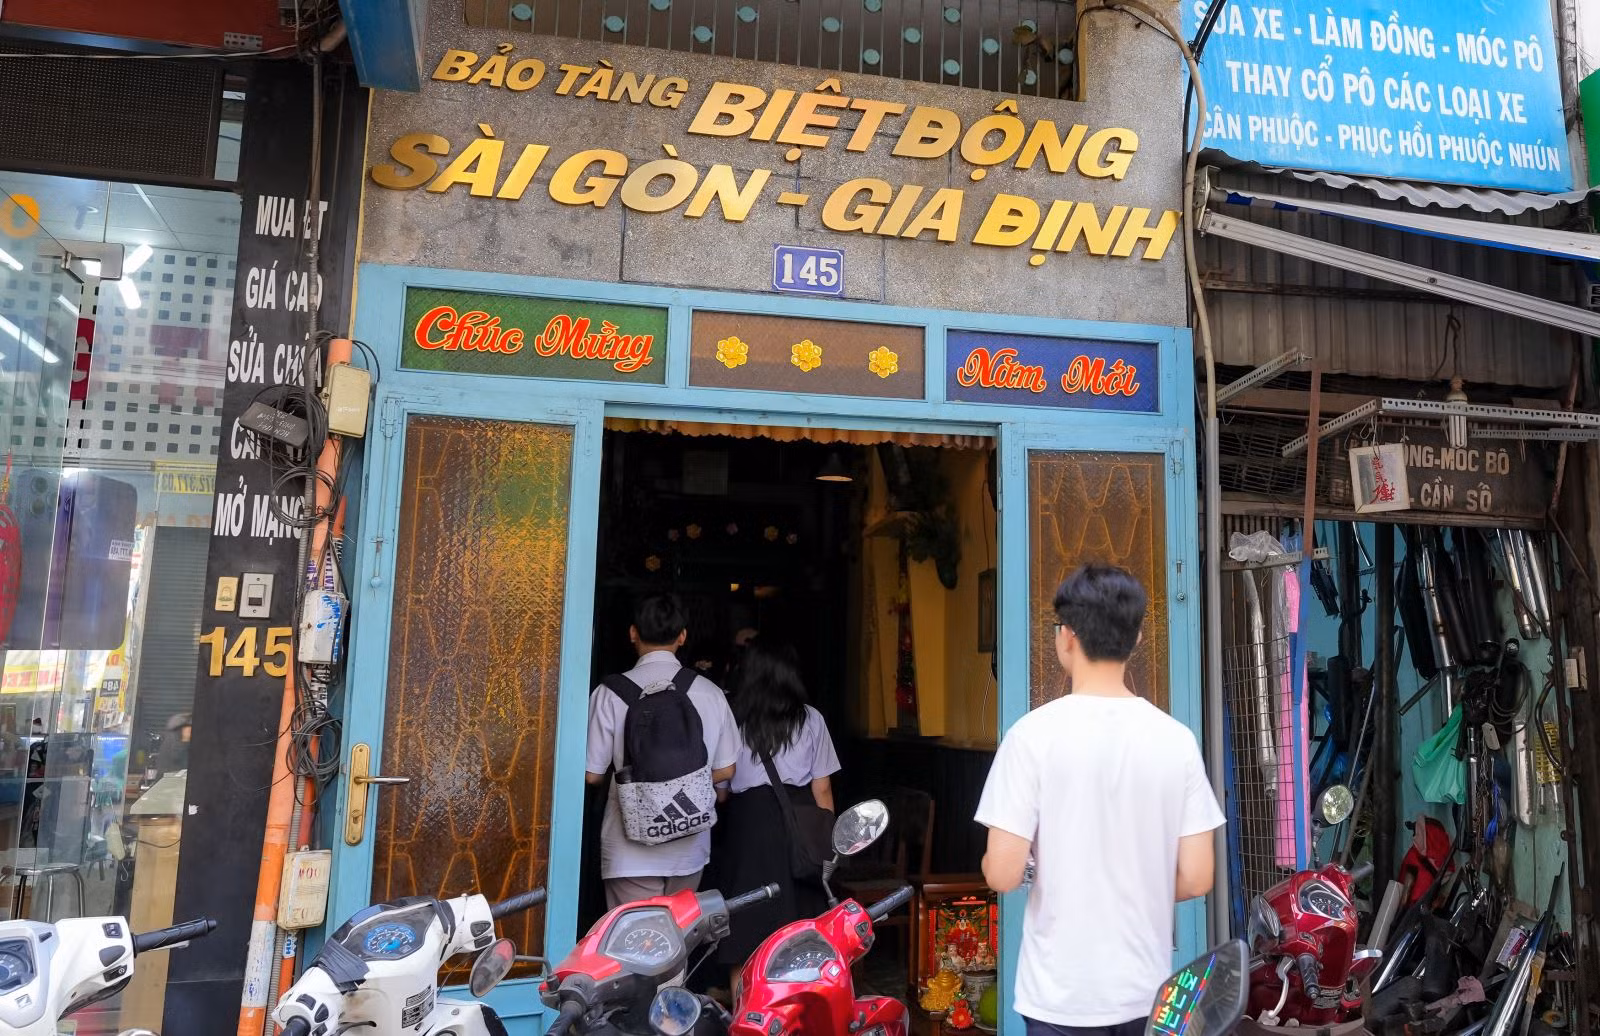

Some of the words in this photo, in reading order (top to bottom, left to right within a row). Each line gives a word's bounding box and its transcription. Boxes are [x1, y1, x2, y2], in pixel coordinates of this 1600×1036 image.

[1251, 6, 1285, 41] XE
[1308, 12, 1363, 50] LÀM
[1370, 10, 1436, 60] ĐỒNG
[1457, 27, 1508, 68] MÓC
[1515, 33, 1544, 73] PÔ
[431, 42, 546, 92] BẢO
[555, 59, 690, 109] TÀNG
[687, 78, 906, 162] BIỆT
[891, 99, 1140, 182] ĐỘNG
[1225, 60, 1292, 98] THAY
[1301, 54, 1334, 103] CỔ
[1343, 65, 1376, 107] PÔ
[1383, 71, 1432, 113] CÁC
[1440, 83, 1492, 126] LOẠI
[1497, 91, 1528, 124] XE
[1247, 111, 1319, 151] PHUỘC
[1338, 123, 1393, 159] PHỤC
[1398, 120, 1433, 160] HỒI
[1439, 132, 1503, 171] PHUỘC
[1509, 138, 1561, 173] NHÚN
[255, 194, 296, 239] MUA
[371, 122, 551, 201] SÀI
[548, 143, 772, 223] GÒN
[821, 176, 965, 243] GIA
[972, 193, 1183, 268] ĐỊNH
[245, 259, 279, 310] GIÁ
[781, 252, 839, 287] 145
[227, 324, 265, 385] SỬA
[414, 305, 524, 355] Chúc
[534, 313, 655, 374] Mừng
[956, 346, 1047, 394] Năm
[1060, 353, 1141, 398] Mới
[213, 474, 248, 538] MỞ
[199, 625, 293, 678] 145
[646, 811, 710, 838] adidas
